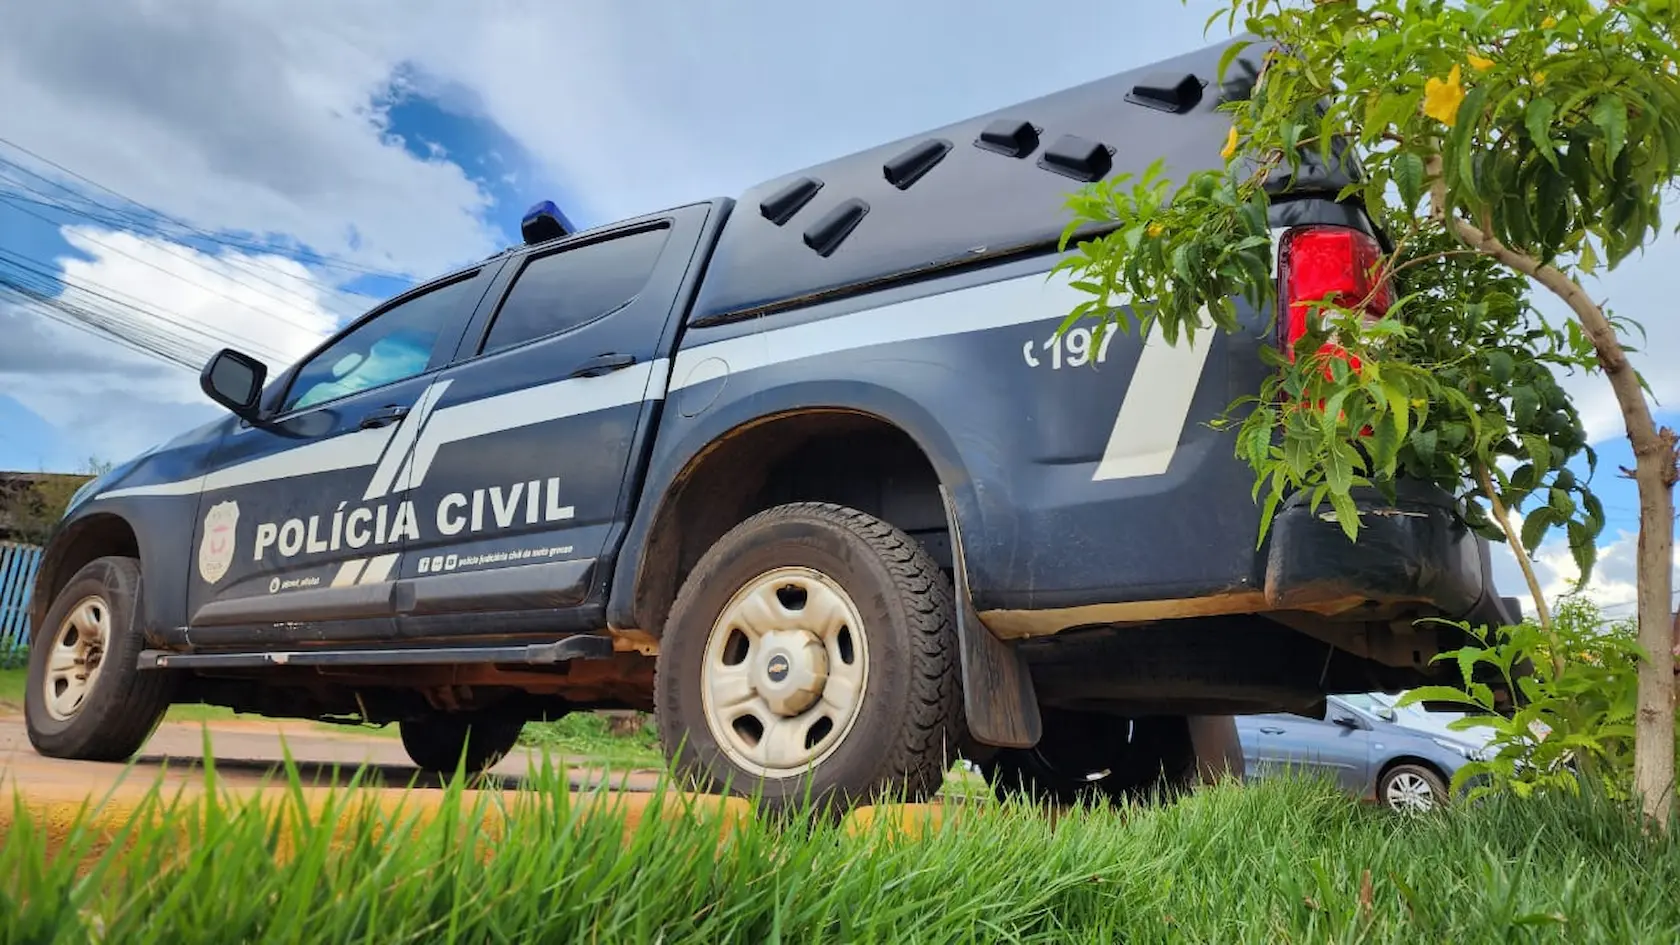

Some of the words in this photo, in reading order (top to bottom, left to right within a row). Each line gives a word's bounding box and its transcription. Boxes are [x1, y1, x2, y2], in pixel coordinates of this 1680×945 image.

[1043, 322, 1118, 369] 197
[254, 501, 420, 560] POLÍCIA
[436, 477, 575, 535] CIVIL
